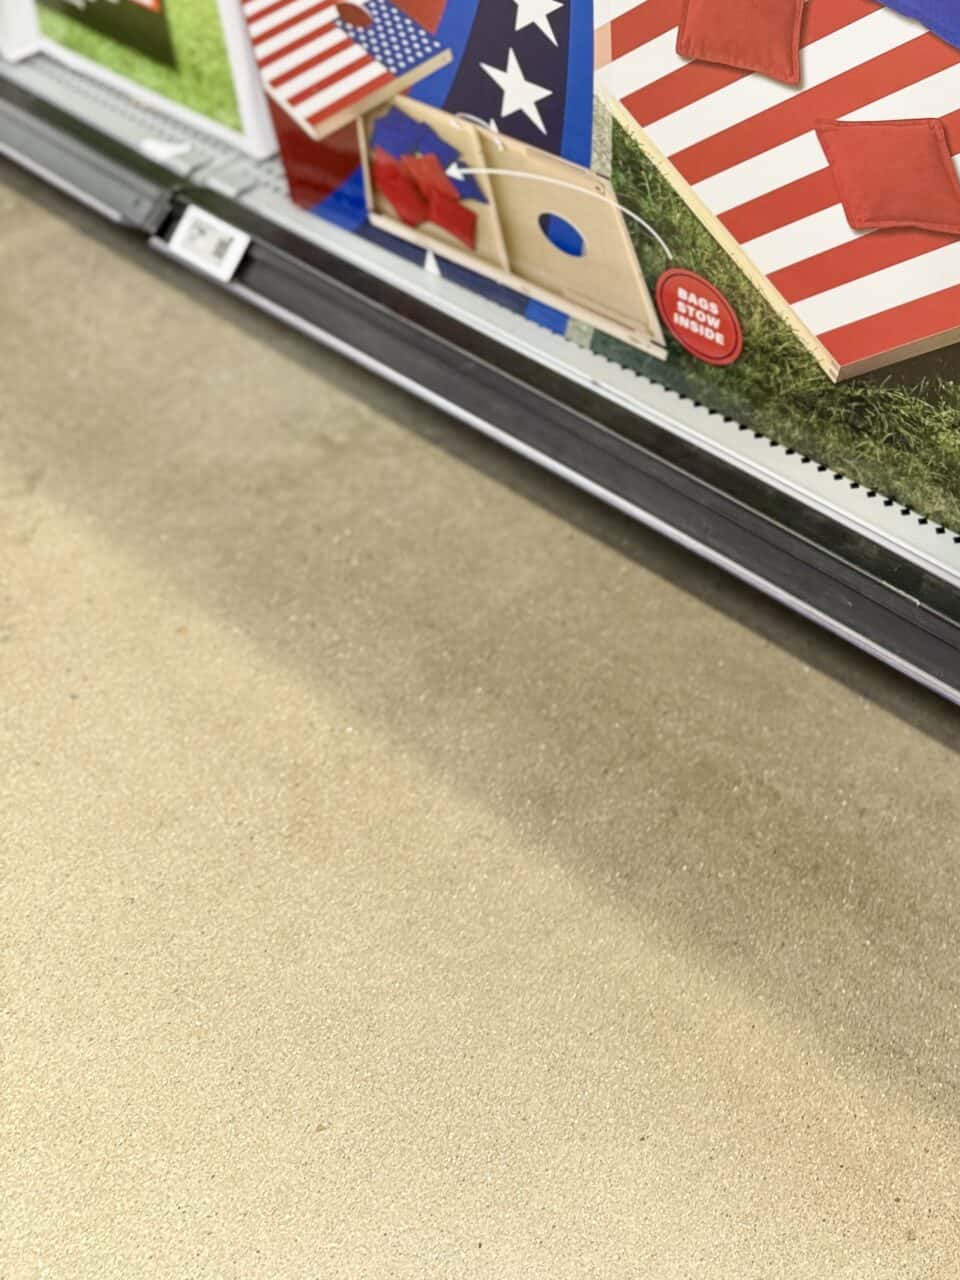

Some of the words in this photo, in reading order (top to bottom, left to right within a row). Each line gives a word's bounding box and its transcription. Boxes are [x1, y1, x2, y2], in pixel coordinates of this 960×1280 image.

[677, 287, 719, 315] BAGS
[677, 300, 720, 329] STOW
[673, 312, 724, 346] INSIDE
